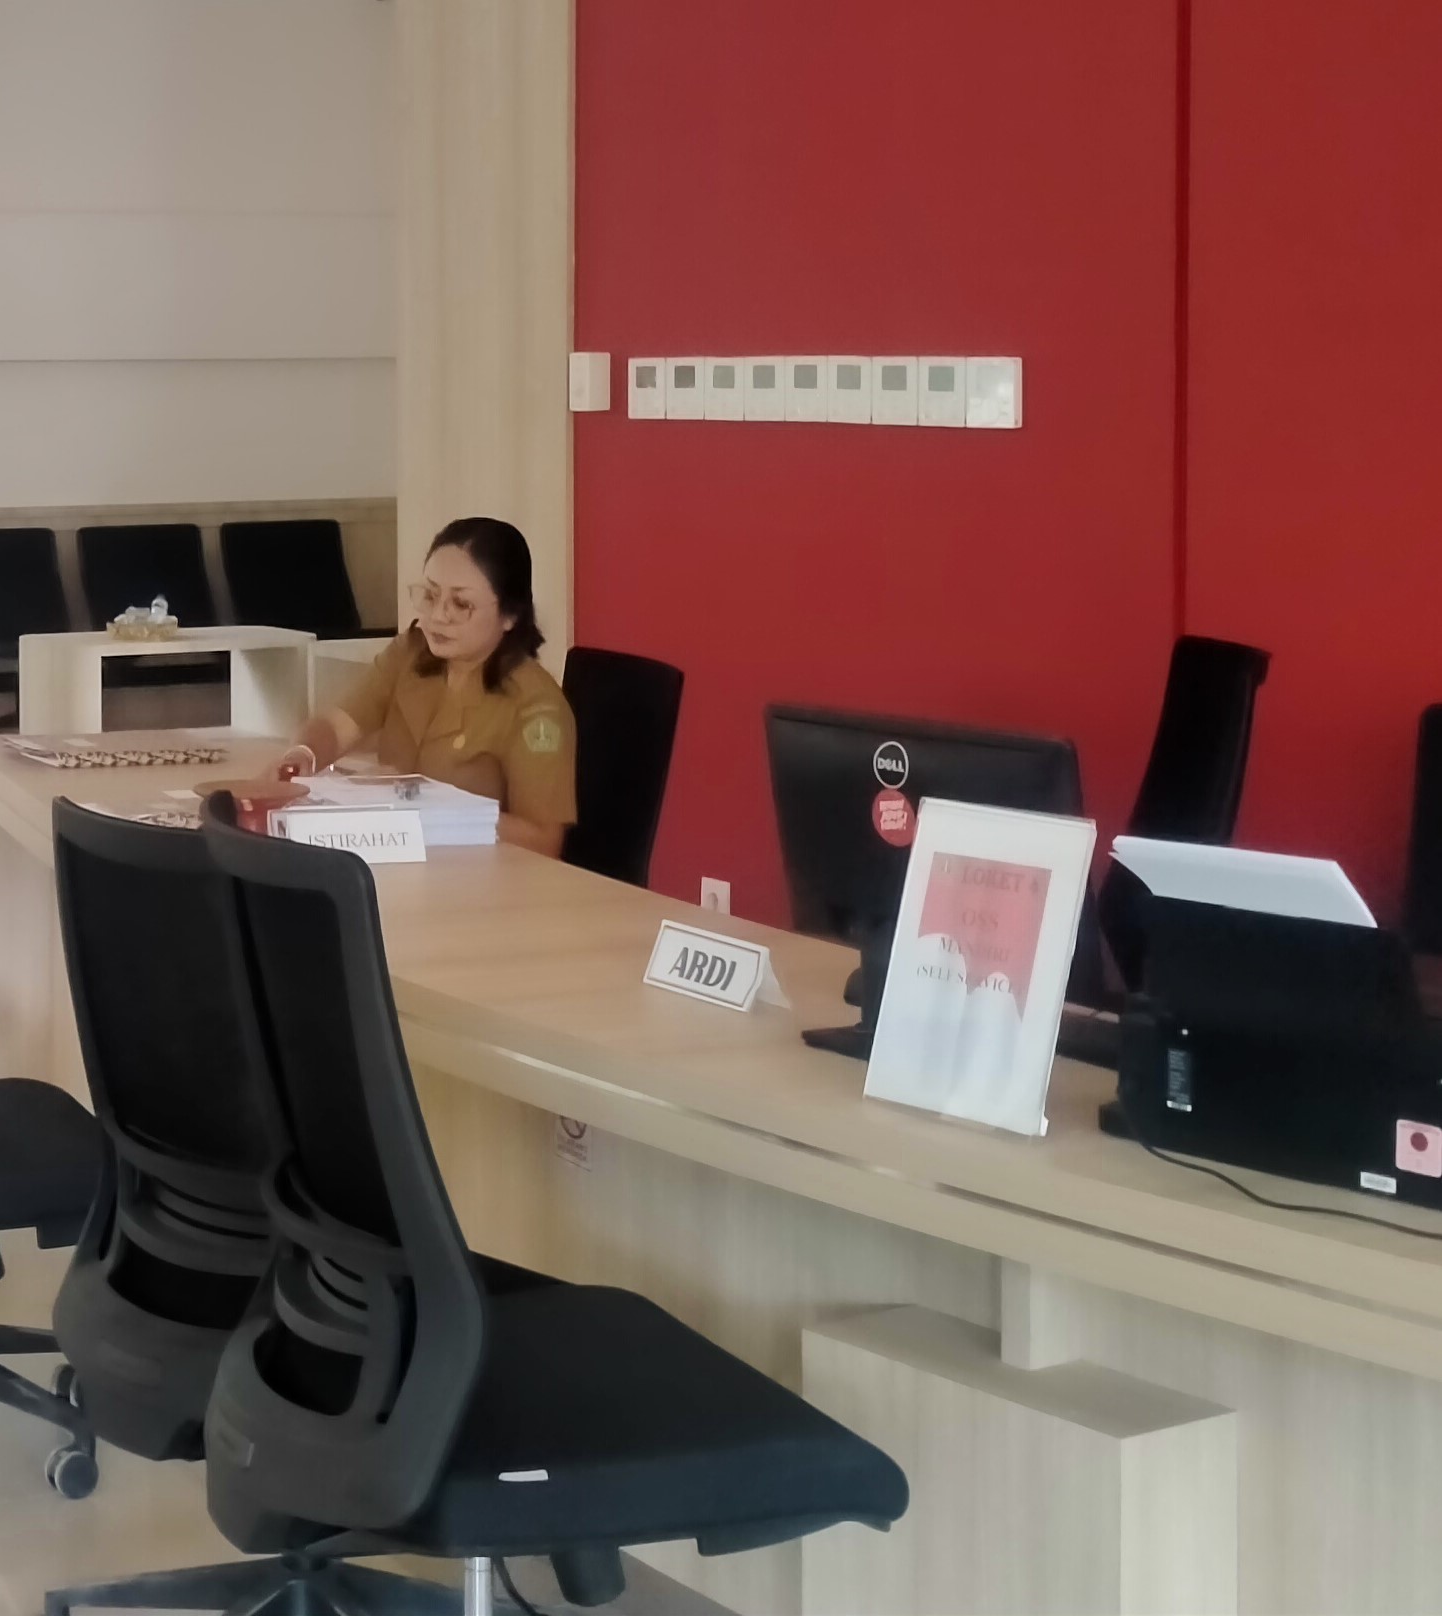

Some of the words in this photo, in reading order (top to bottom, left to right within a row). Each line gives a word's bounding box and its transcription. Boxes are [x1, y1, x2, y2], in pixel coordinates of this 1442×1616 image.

[877, 757, 905, 773] DELL
[308, 831, 409, 848] ISTIRAHAT
[668, 946, 738, 991] ARDI
